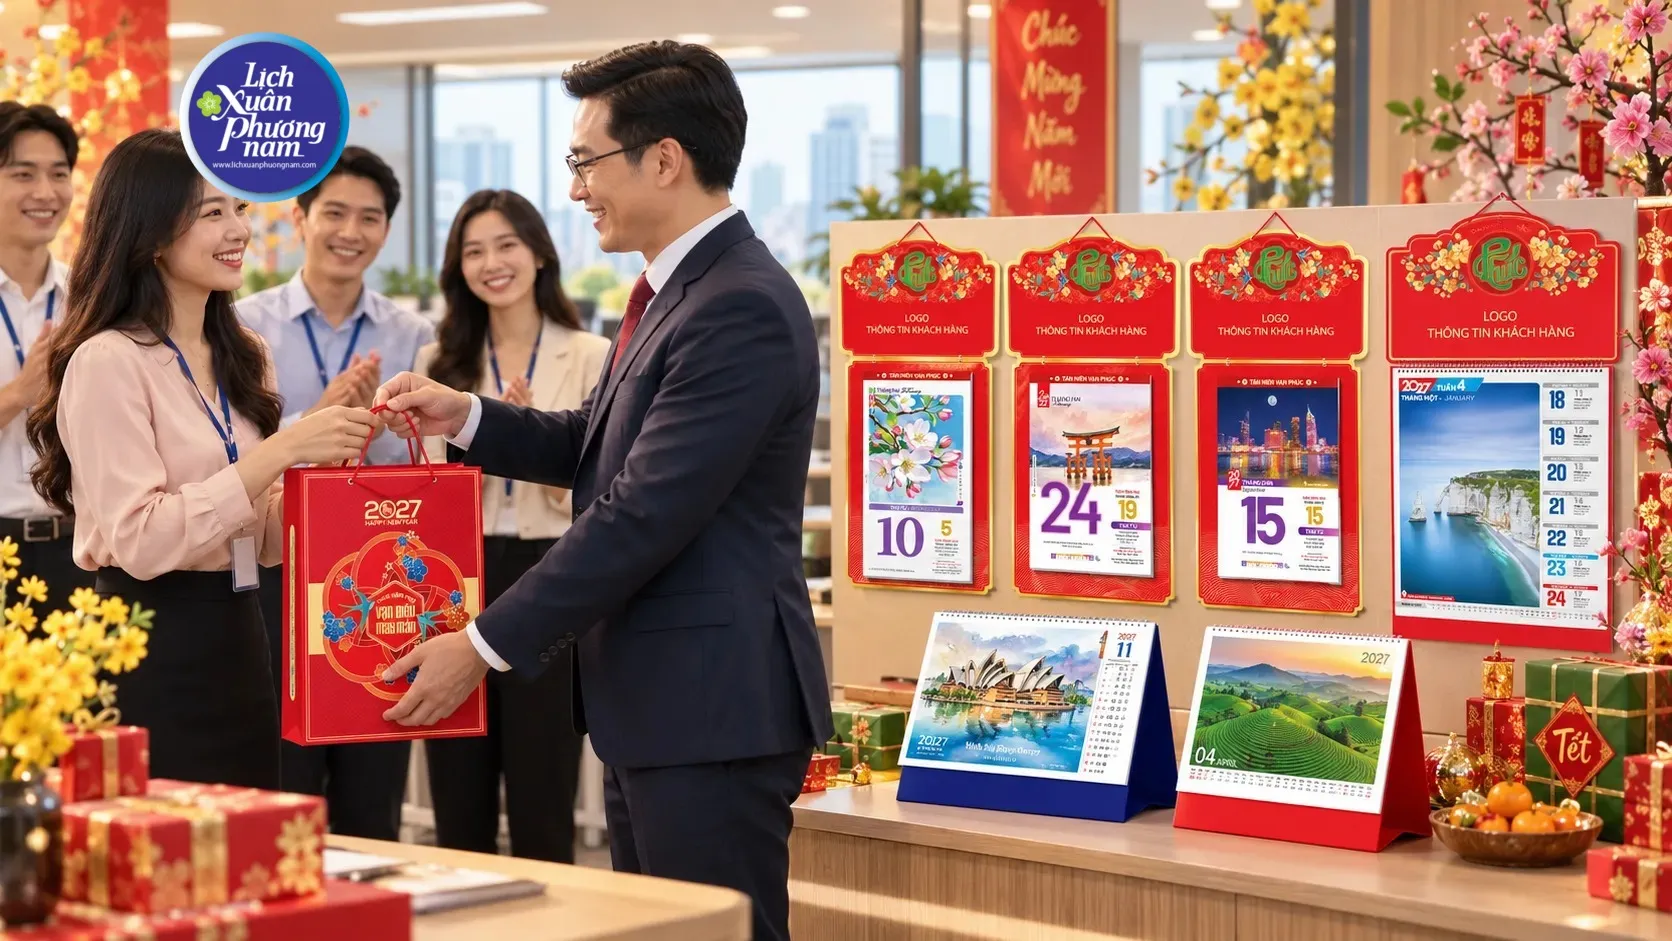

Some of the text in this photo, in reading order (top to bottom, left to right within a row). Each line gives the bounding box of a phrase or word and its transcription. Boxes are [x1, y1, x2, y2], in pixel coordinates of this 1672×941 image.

[904, 314, 929, 323] LOGO
[1078, 314, 1105, 323] LOGO
[1261, 313, 1290, 323] LOGO
[1483, 310, 1518, 322] LOGO
[866, 324, 969, 335] THÔNG TIN KHÁCH HÀNG
[1036, 325, 1147, 336] THÔNG TIN KHÁCH HÀNG
[1218, 325, 1335, 336] THÔNG TIN KHÁCH HÀNG
[1427, 324, 1575, 339] THÔNG TIN KHÁCH HÀNG
[1401, 380, 1433, 394] 2027
[1457, 379, 1466, 391] 4
[1549, 390, 1565, 409] 18
[1549, 427, 1565, 445] 19
[1547, 463, 1567, 481] 20
[1041, 481, 1102, 535] 24
[1118, 499, 1137, 520] 19
[1549, 497, 1564, 515] 21
[1241, 496, 1286, 545] 15
[1306, 506, 1324, 525] 15
[941, 520, 952, 536] 5
[877, 516, 924, 557] 10
[1547, 530, 1566, 547] 22
[1547, 560, 1566, 576] 23
[1547, 590, 1566, 607] 24
[1117, 642, 1132, 658] 11
[1361, 652, 1391, 665] 2027
[1552, 727, 1592, 764] Tết
[1195, 746, 1216, 765] 04
